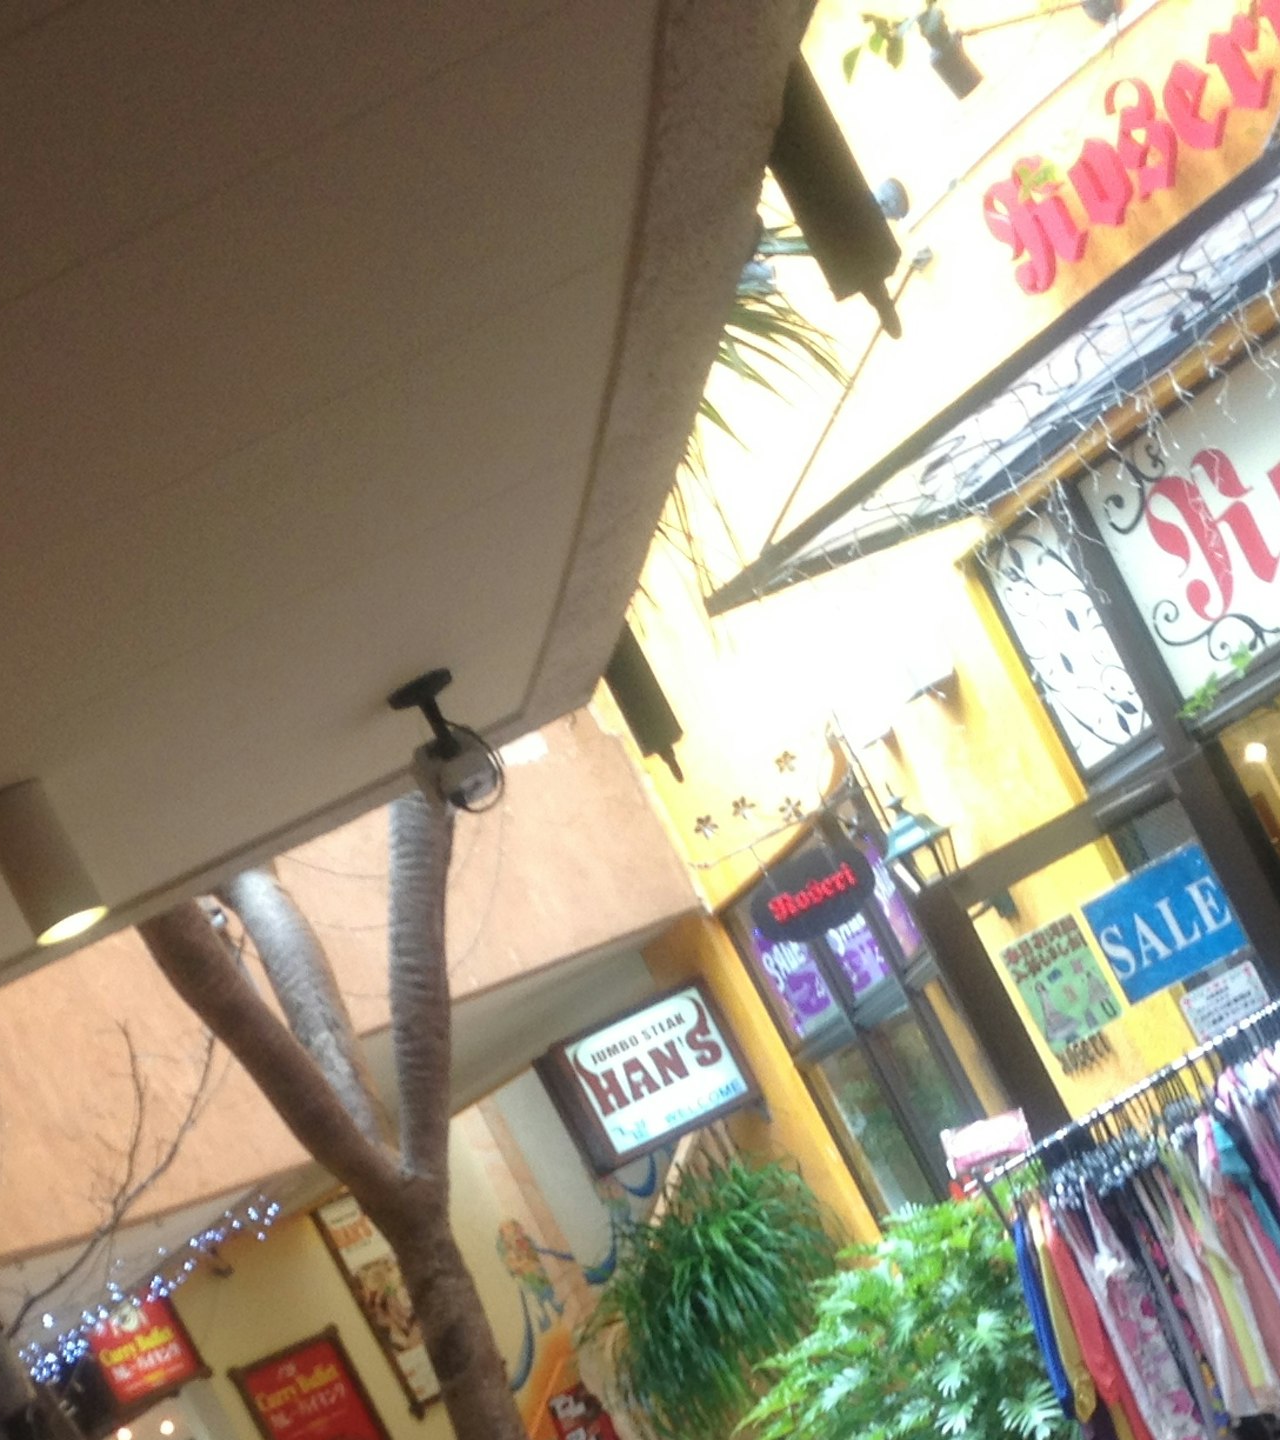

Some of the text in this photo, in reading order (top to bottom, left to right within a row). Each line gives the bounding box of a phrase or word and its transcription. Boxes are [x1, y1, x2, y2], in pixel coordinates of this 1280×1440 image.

[1100, 875, 1233, 980] SALE
[576, 998, 723, 1117] HAN'S
[590, 1035, 639, 1066] JUMBO
